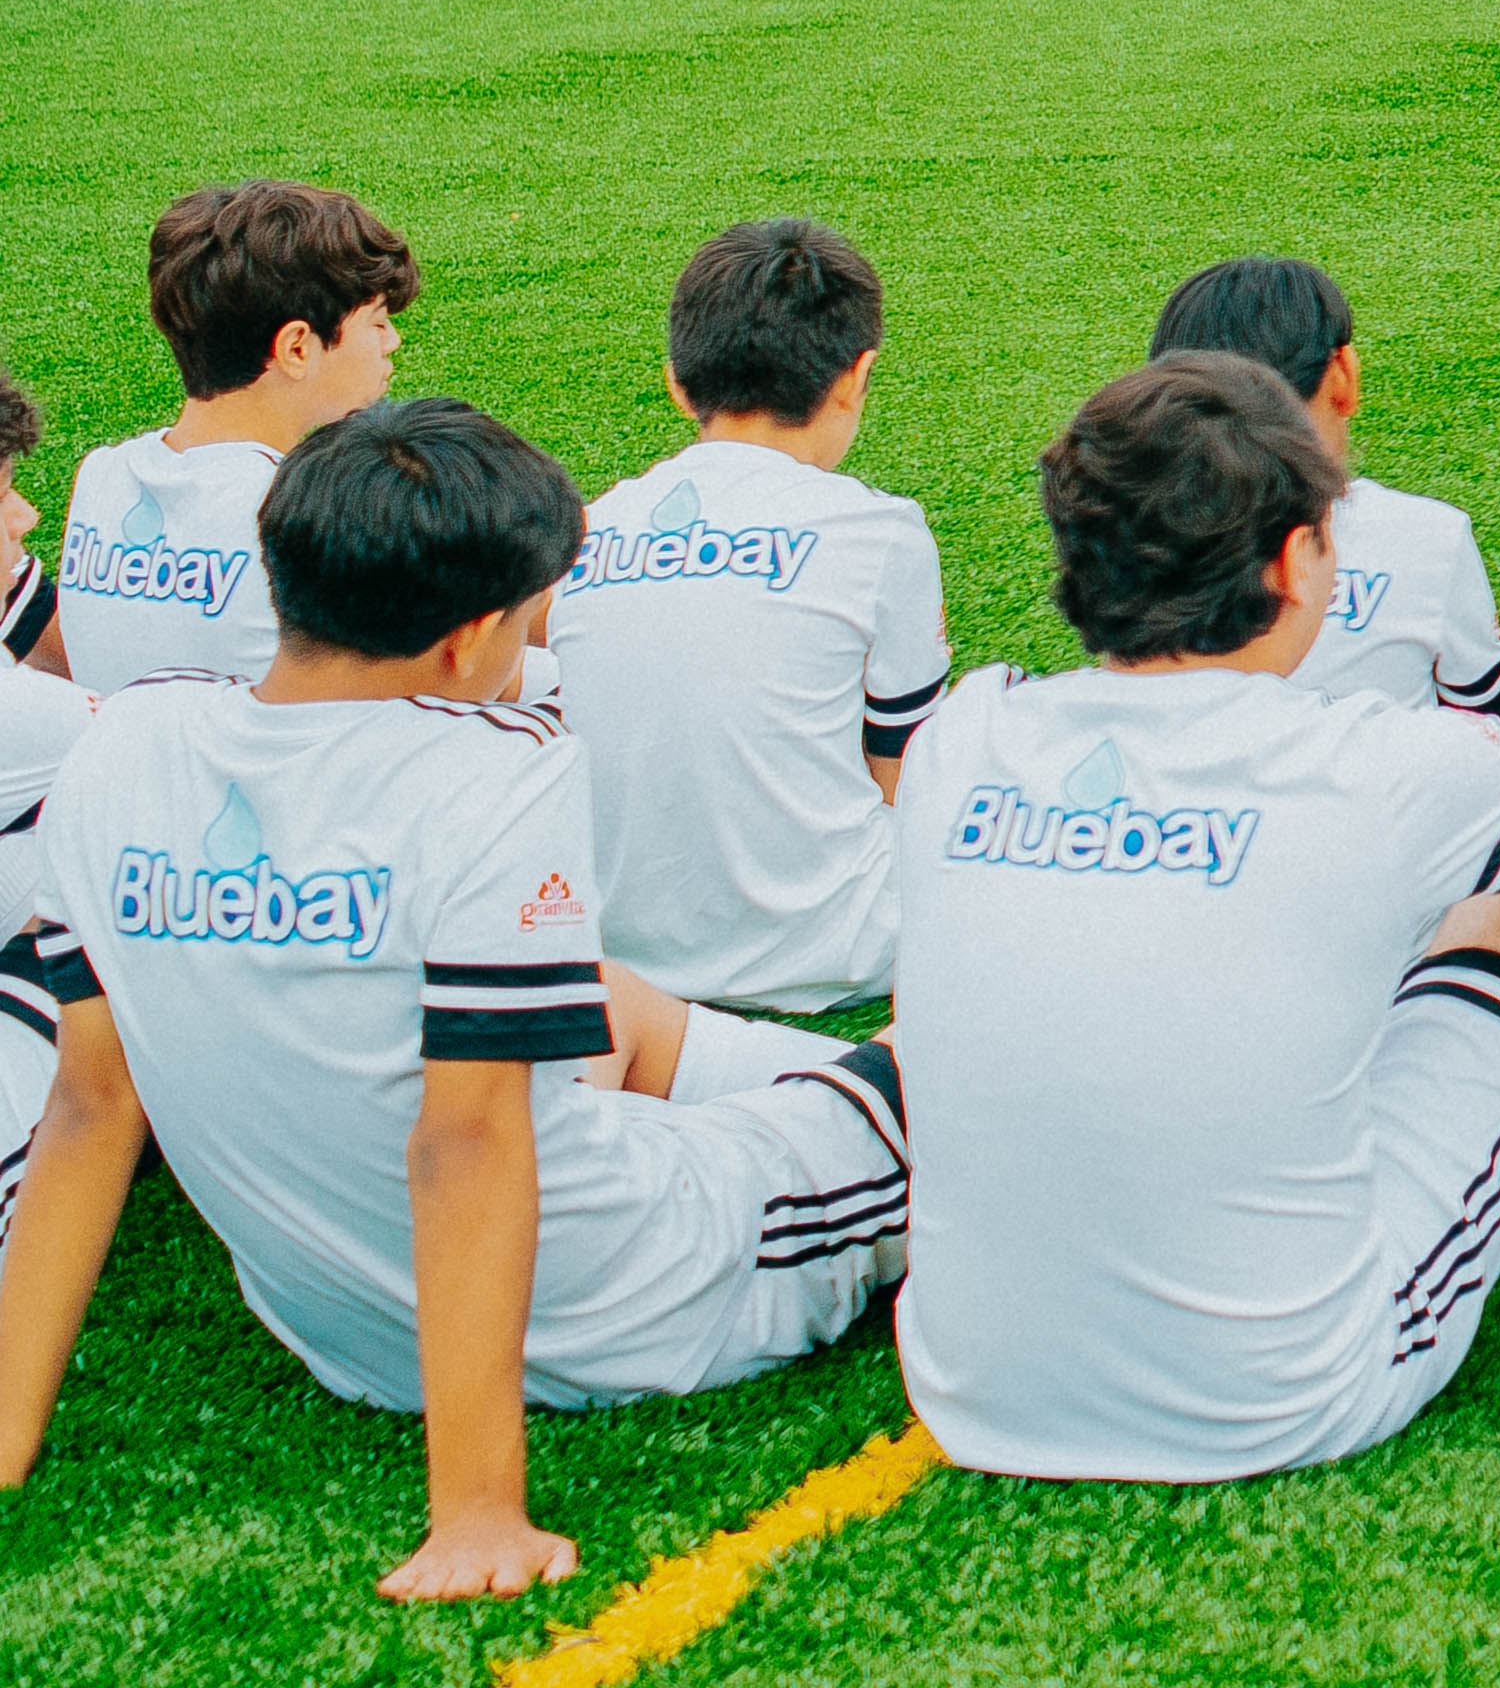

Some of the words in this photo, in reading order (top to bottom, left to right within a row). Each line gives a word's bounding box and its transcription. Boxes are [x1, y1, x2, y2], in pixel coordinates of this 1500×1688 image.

[60, 522, 252, 617] Bluebay
[946, 784, 1259, 887] Bluebay
[112, 847, 391, 962] Bluebay
